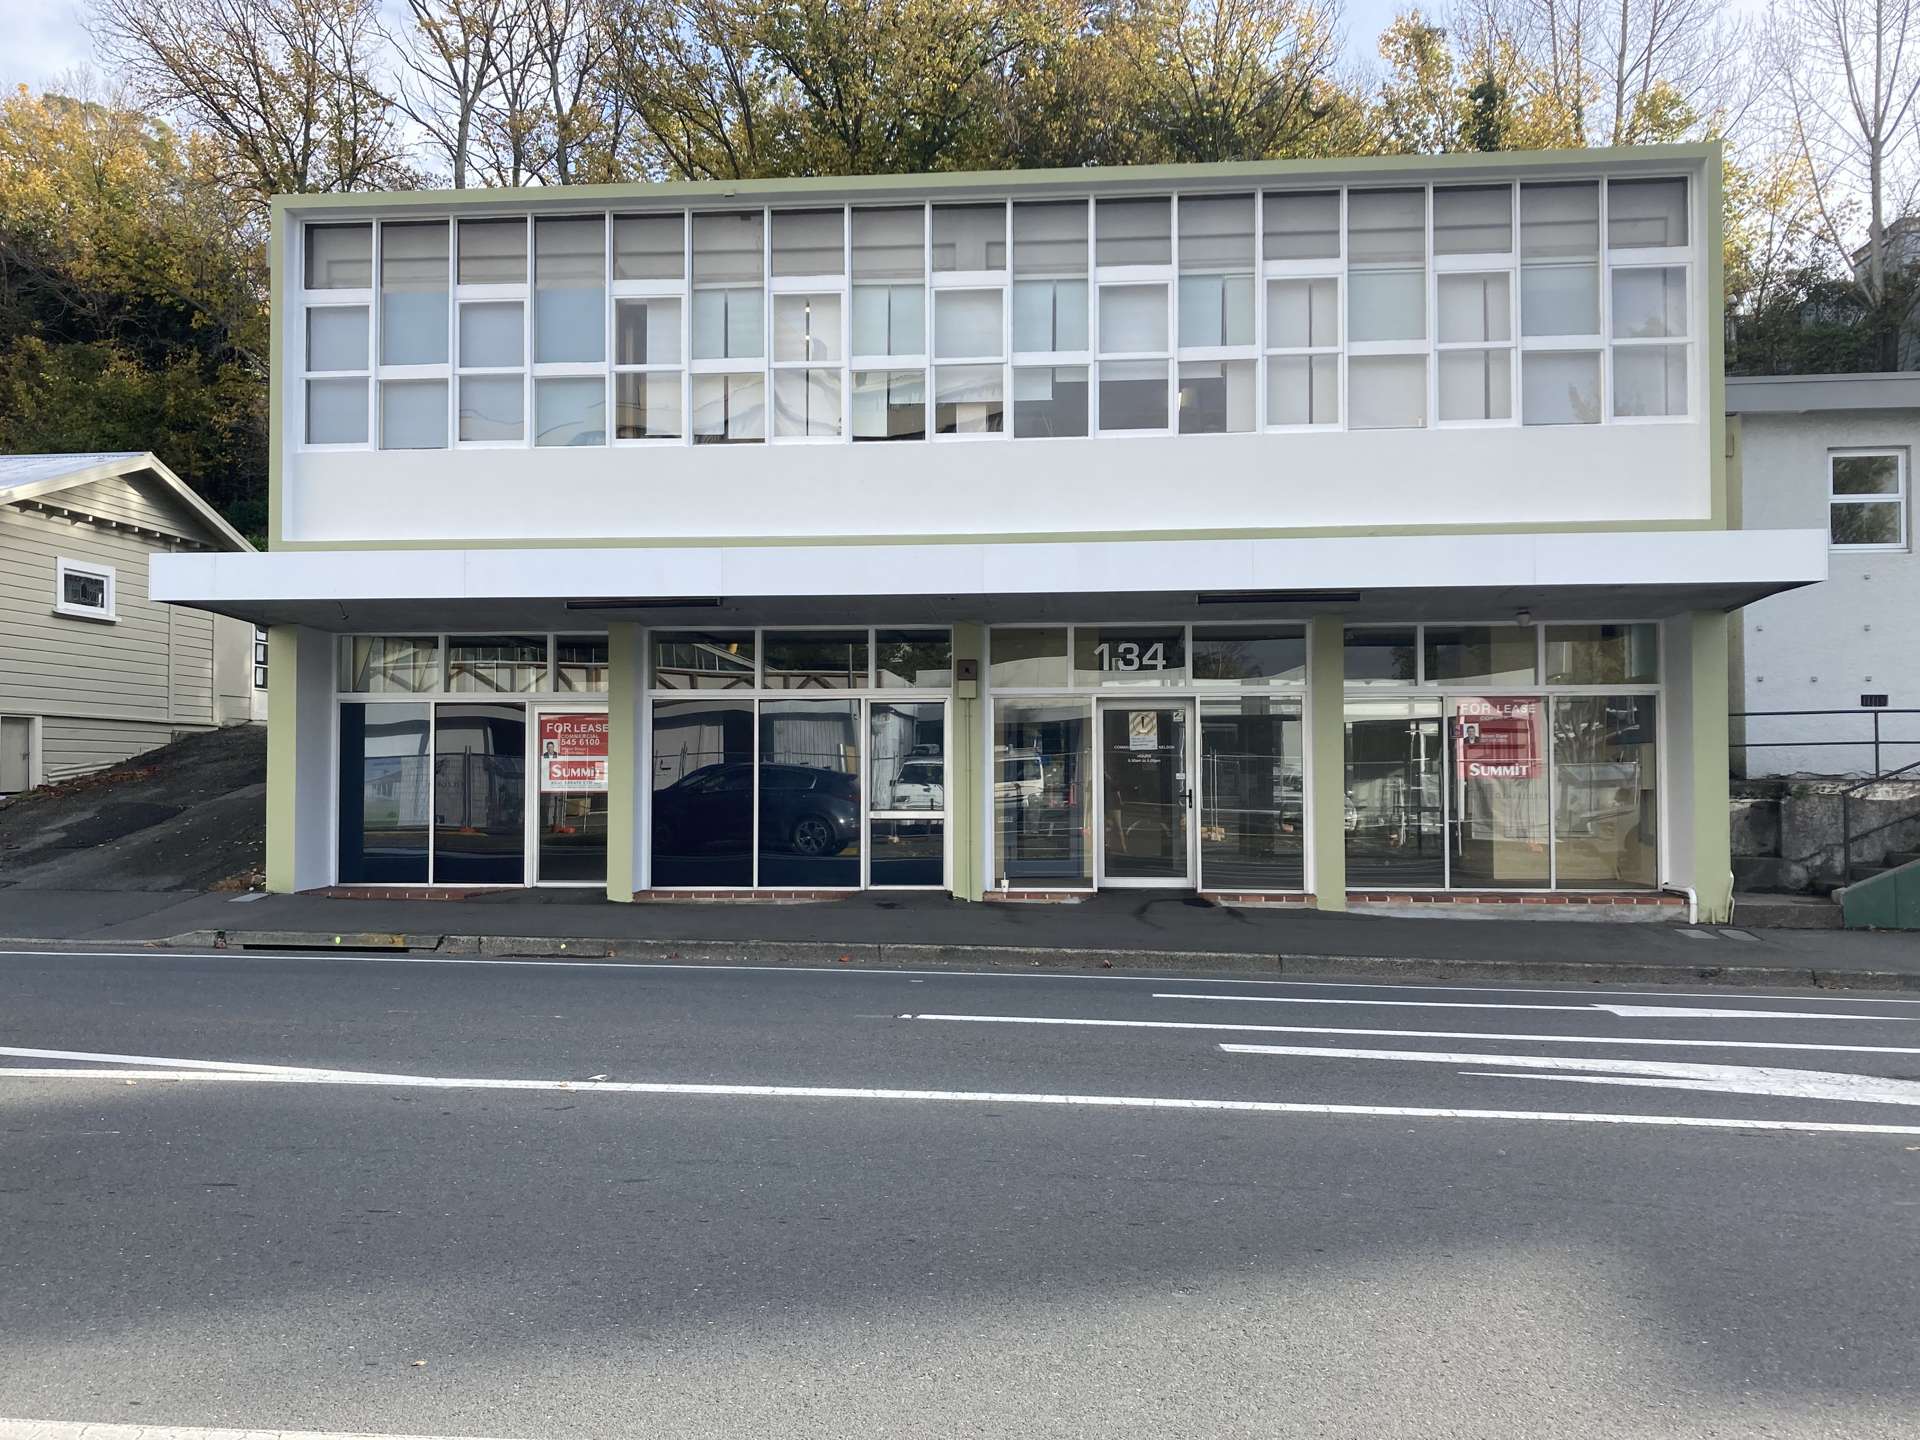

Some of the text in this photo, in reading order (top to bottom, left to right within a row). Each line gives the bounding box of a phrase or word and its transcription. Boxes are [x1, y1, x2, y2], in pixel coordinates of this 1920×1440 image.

[1094, 643, 1167, 671] 134
[1460, 704, 1536, 714] FOR LEASE
[546, 722, 608, 732] FOR LEASE
[561, 738, 600, 746] 545 6100
